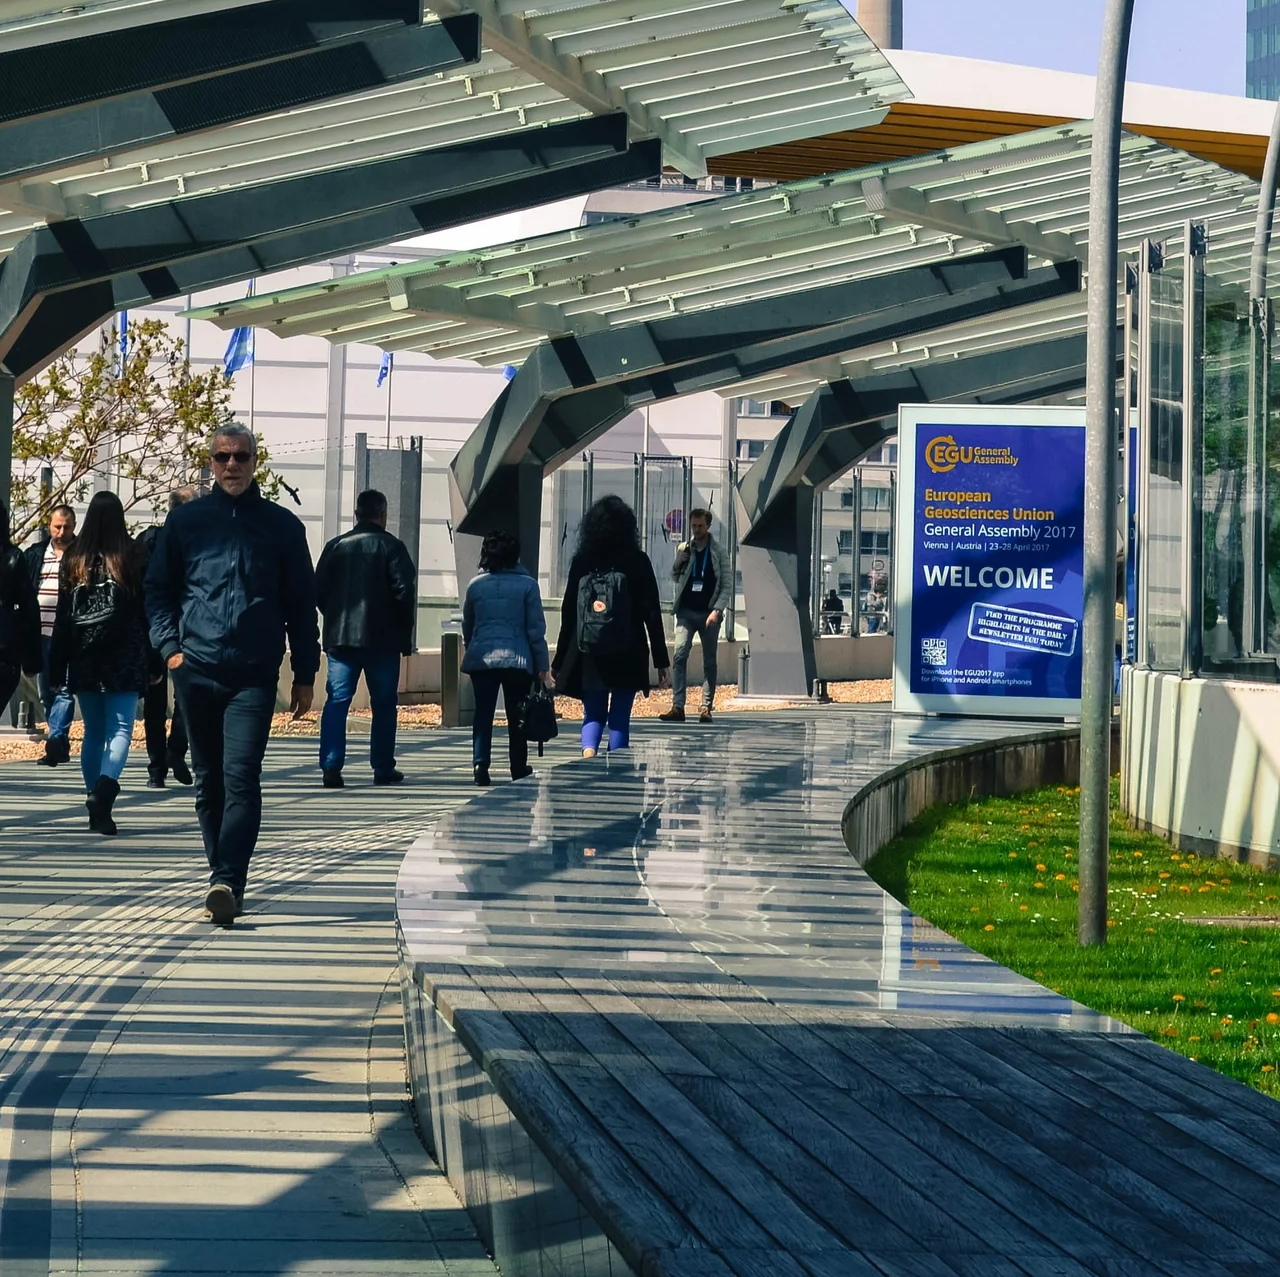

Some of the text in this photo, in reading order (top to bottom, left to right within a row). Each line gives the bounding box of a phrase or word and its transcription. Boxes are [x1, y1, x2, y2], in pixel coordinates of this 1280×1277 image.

[934, 446, 973, 463] EGU
[973, 446, 1011, 456] General
[973, 455, 1019, 467] Assembly
[925, 489, 991, 505] European
[924, 506, 1054, 520] Geosciences Union
[924, 523, 1076, 541] General Assembly 2017
[923, 541, 949, 550] Vienna
[956, 542, 982, 550] Austria
[1013, 543, 1030, 552] April
[1031, 543, 1050, 551] 2017
[923, 565, 1054, 590] WELCOME
[985, 610, 1063, 630] FIND THE PROGRAMME
[977, 618, 1022, 632] HIGHLIGHTS
[1032, 627, 1046, 636] THE
[1047, 629, 1068, 640] DAILY
[978, 627, 1064, 649] NEWSLETTER EGU TODAY
[921, 668, 953, 676] Download
[964, 669, 992, 677] EGU2017
[953, 676, 965, 684] and
[992, 678, 1032, 686] smartphones
